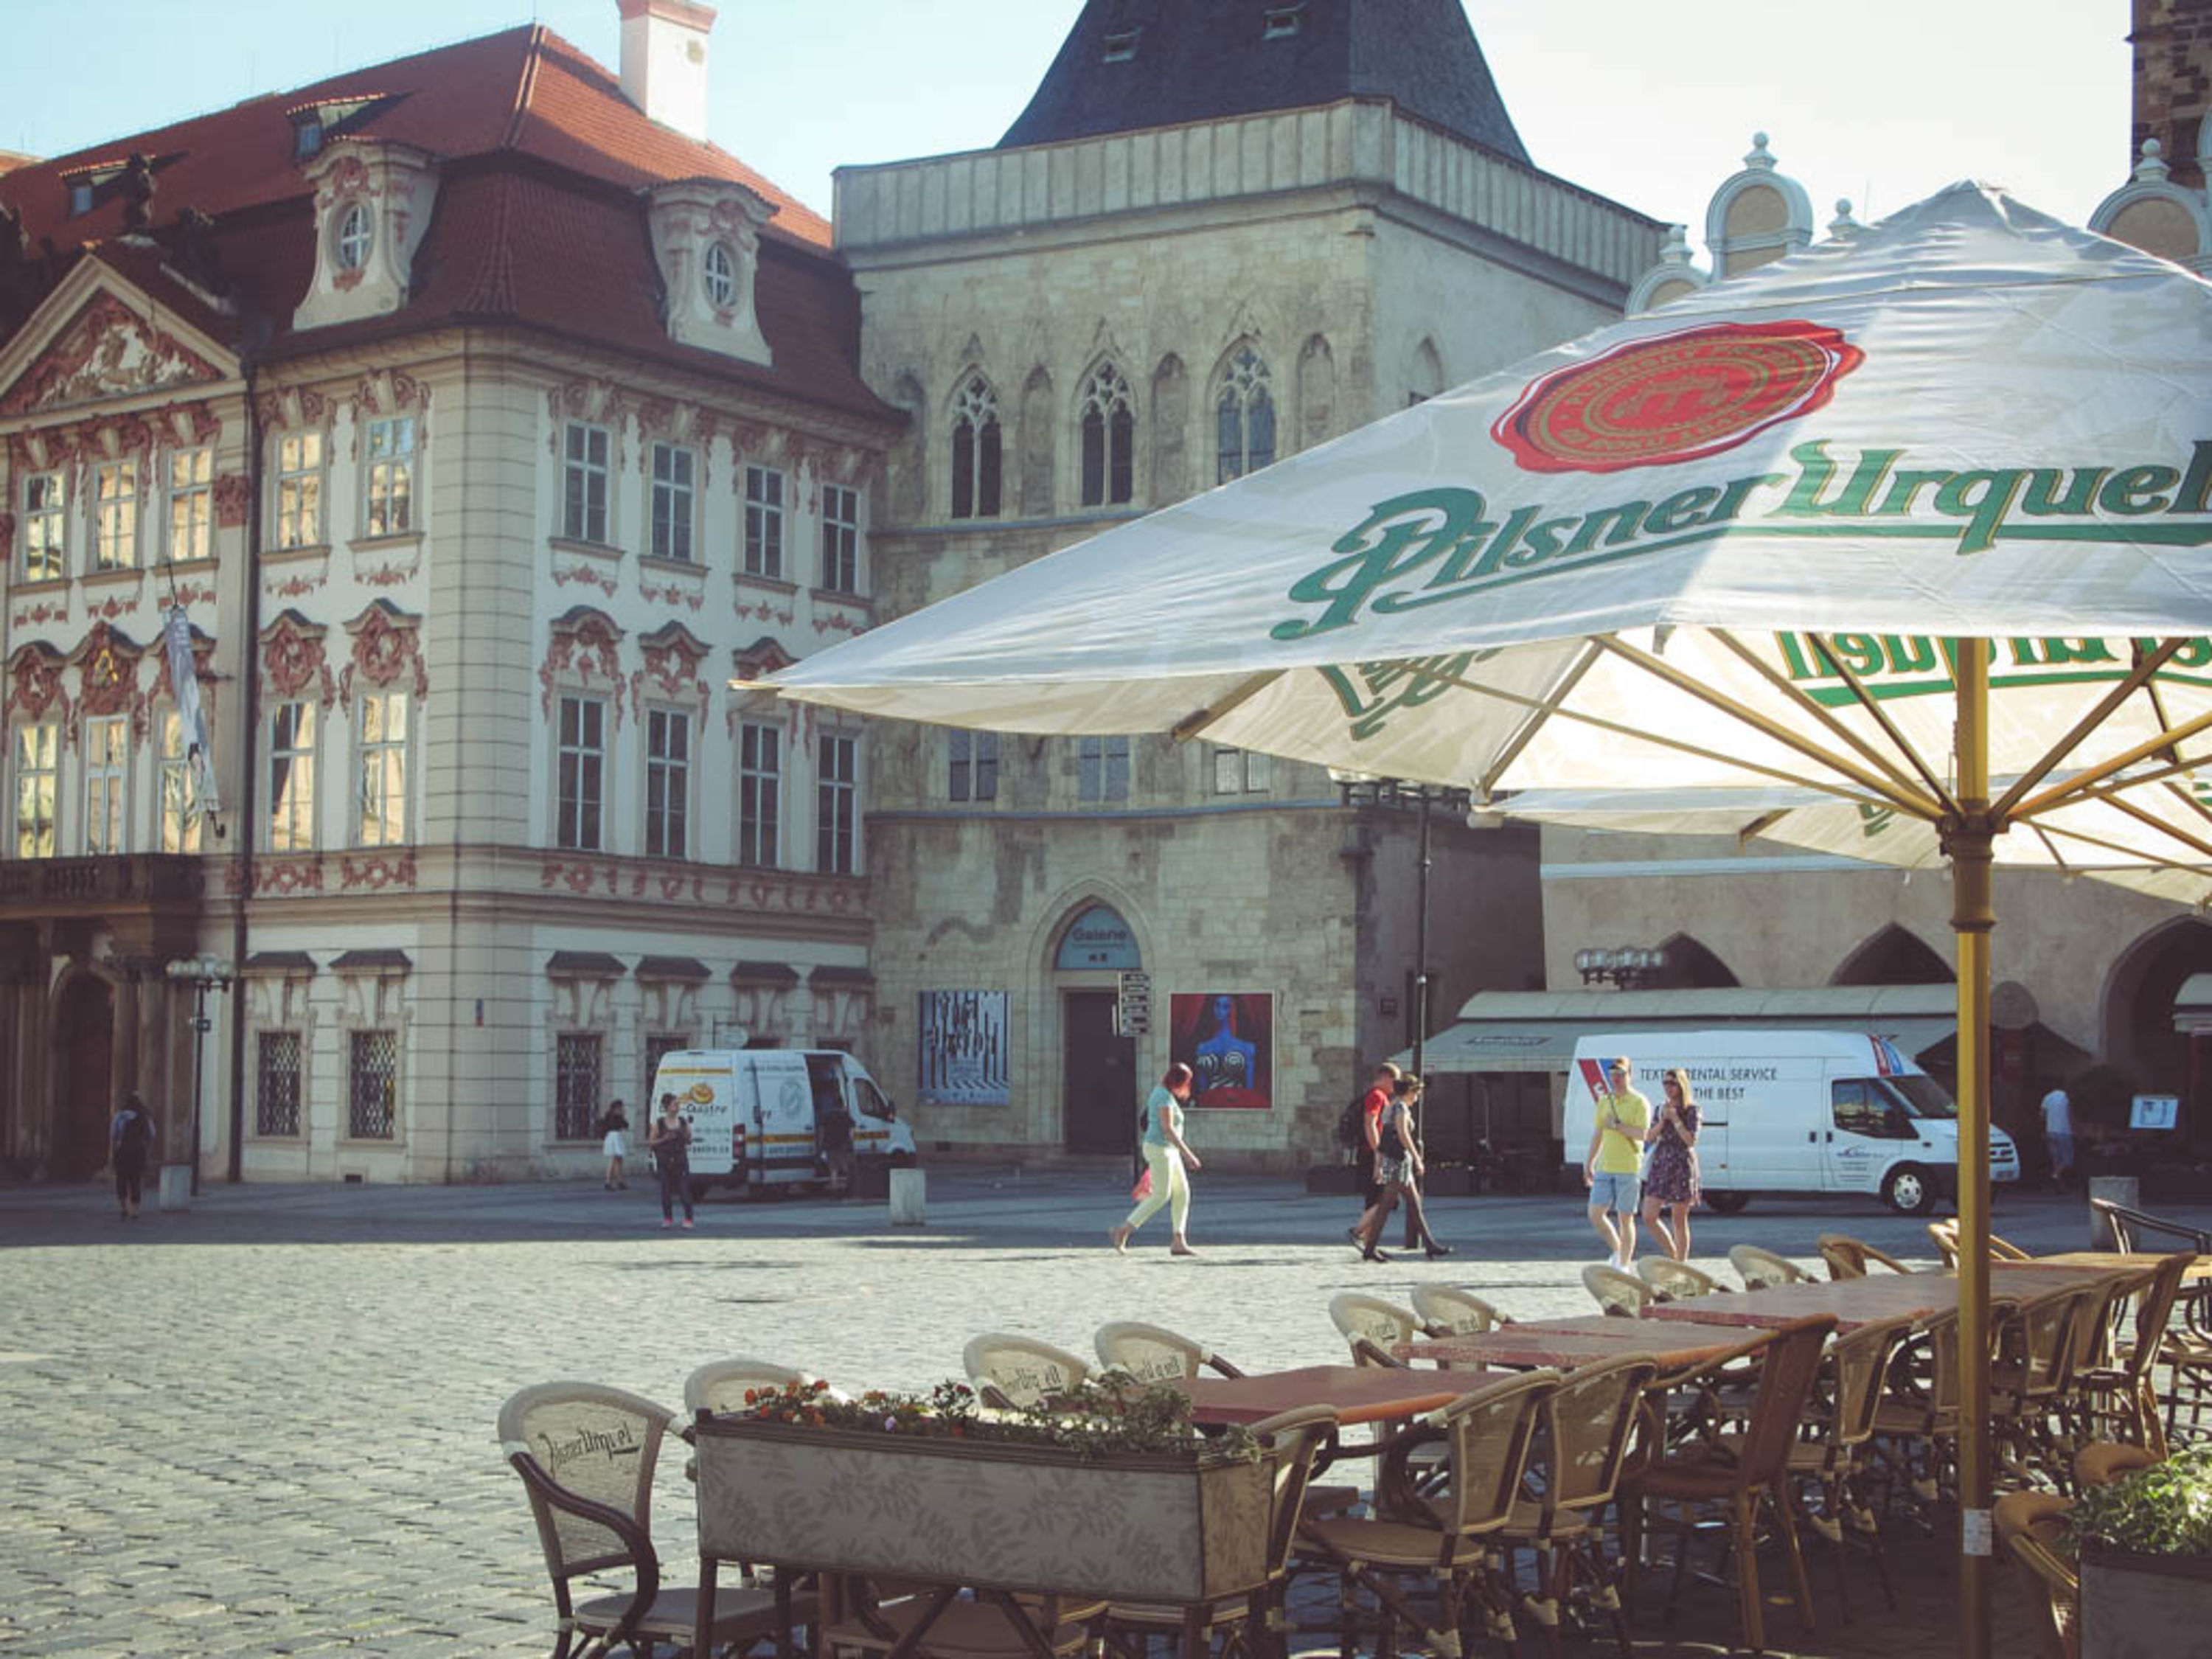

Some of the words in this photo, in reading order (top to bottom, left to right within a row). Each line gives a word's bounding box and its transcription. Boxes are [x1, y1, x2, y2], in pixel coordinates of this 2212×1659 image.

[1270, 473, 1787, 641] Pilsner
[1762, 438, 2212, 556] Urquel
[1730, 1068, 1777, 1081] SERVICE
[1694, 1088, 1714, 1099] THE
[1717, 1088, 1745, 1099] BEST
